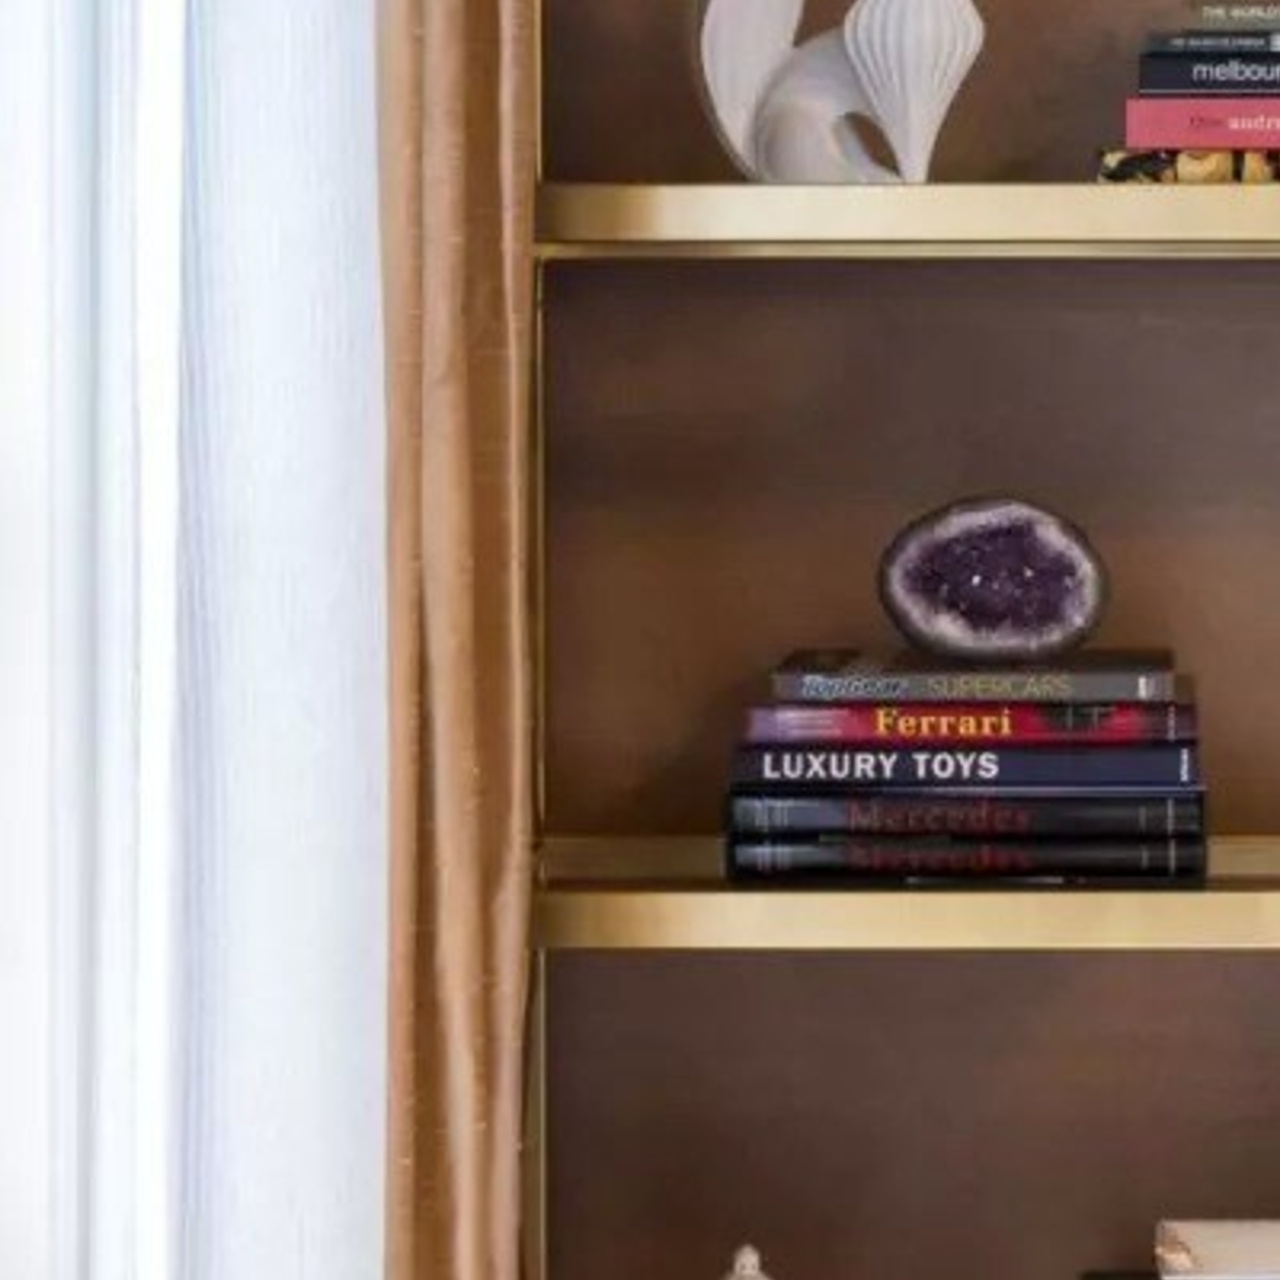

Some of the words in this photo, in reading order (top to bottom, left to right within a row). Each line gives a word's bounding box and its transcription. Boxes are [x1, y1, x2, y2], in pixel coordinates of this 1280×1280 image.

[927, 673, 1073, 698] SUPERCARS
[875, 707, 1012, 738] Ferrari
[763, 753, 899, 780] LUXURY
[911, 753, 1000, 780] TOYS
[846, 803, 1032, 832] Mercedes
